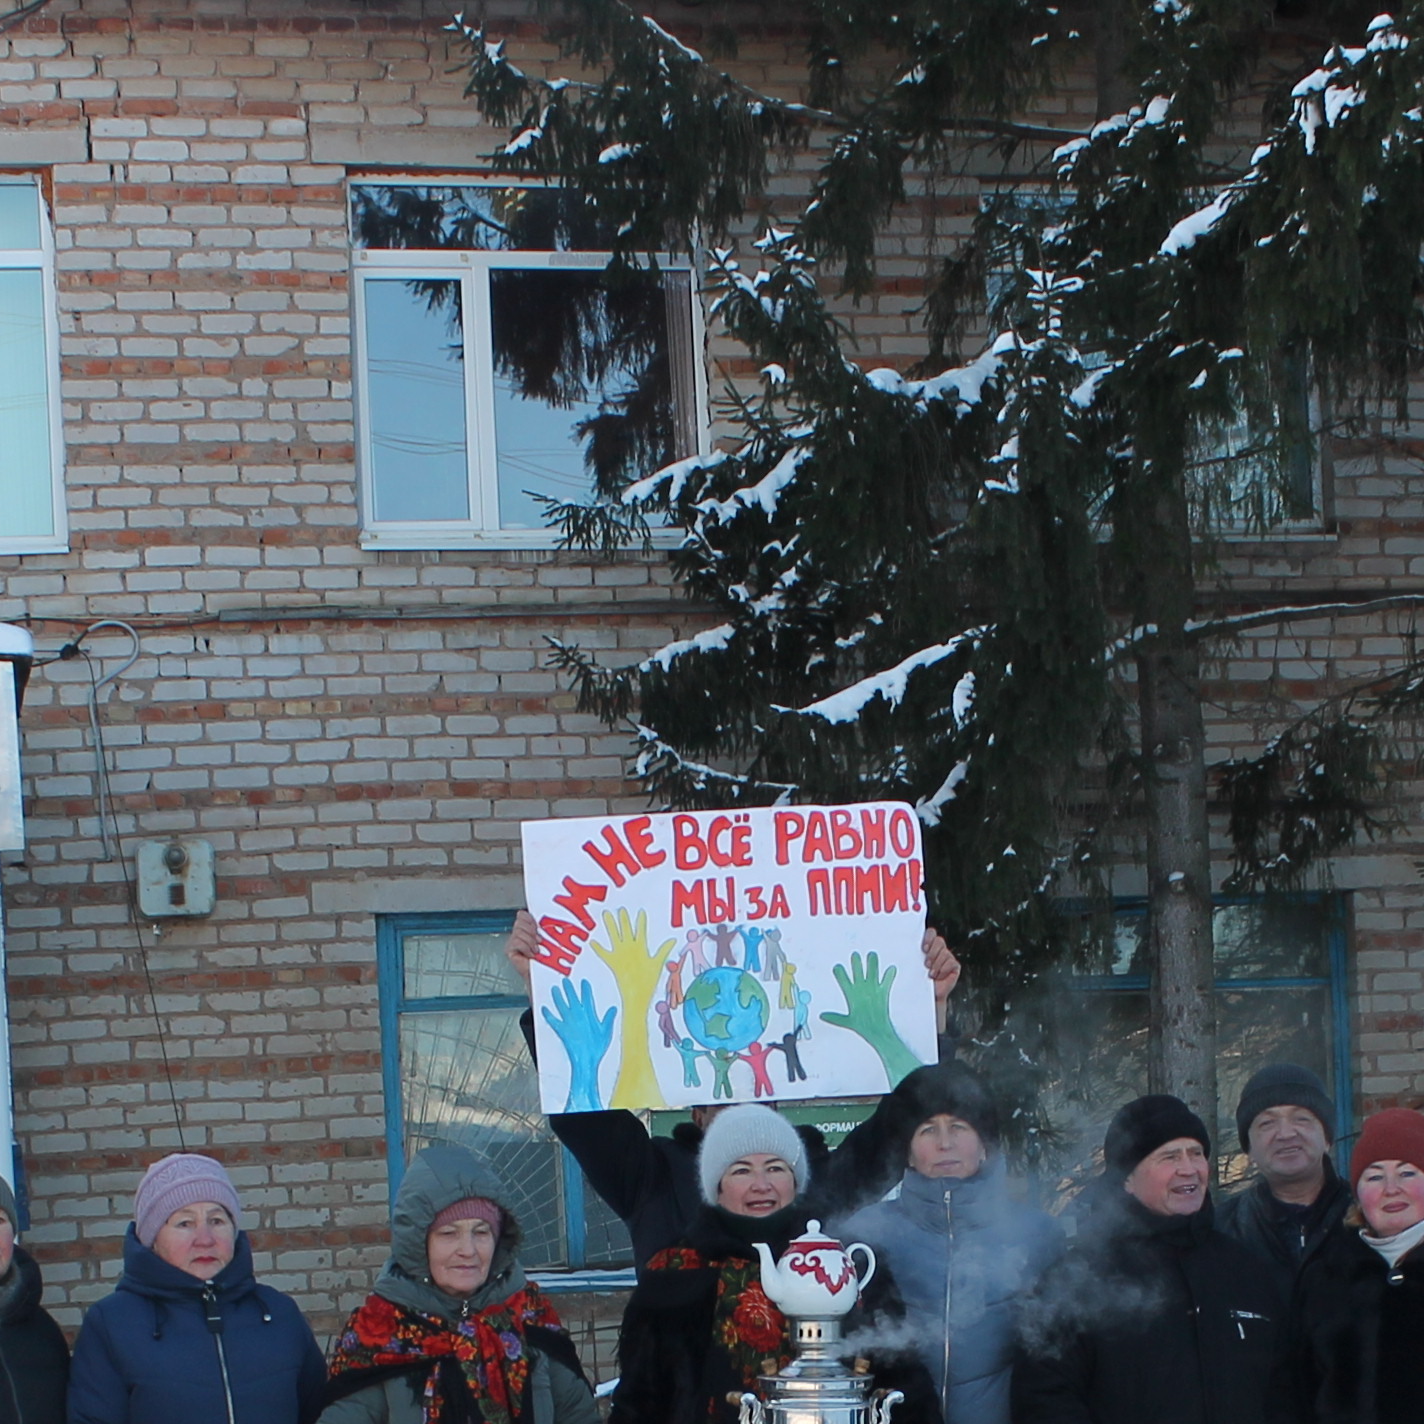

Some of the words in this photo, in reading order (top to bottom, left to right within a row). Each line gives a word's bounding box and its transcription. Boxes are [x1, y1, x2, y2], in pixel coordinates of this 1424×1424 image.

[533, 874, 609, 978] НАМ
[582, 814, 667, 889] НЕ
[672, 812, 754, 871] ВСЁ
[774, 807, 917, 867] РАВНО
[669, 875, 736, 929] МЫ
[744, 882, 792, 921] ЗА
[806, 858, 925, 917] ППМИ!
